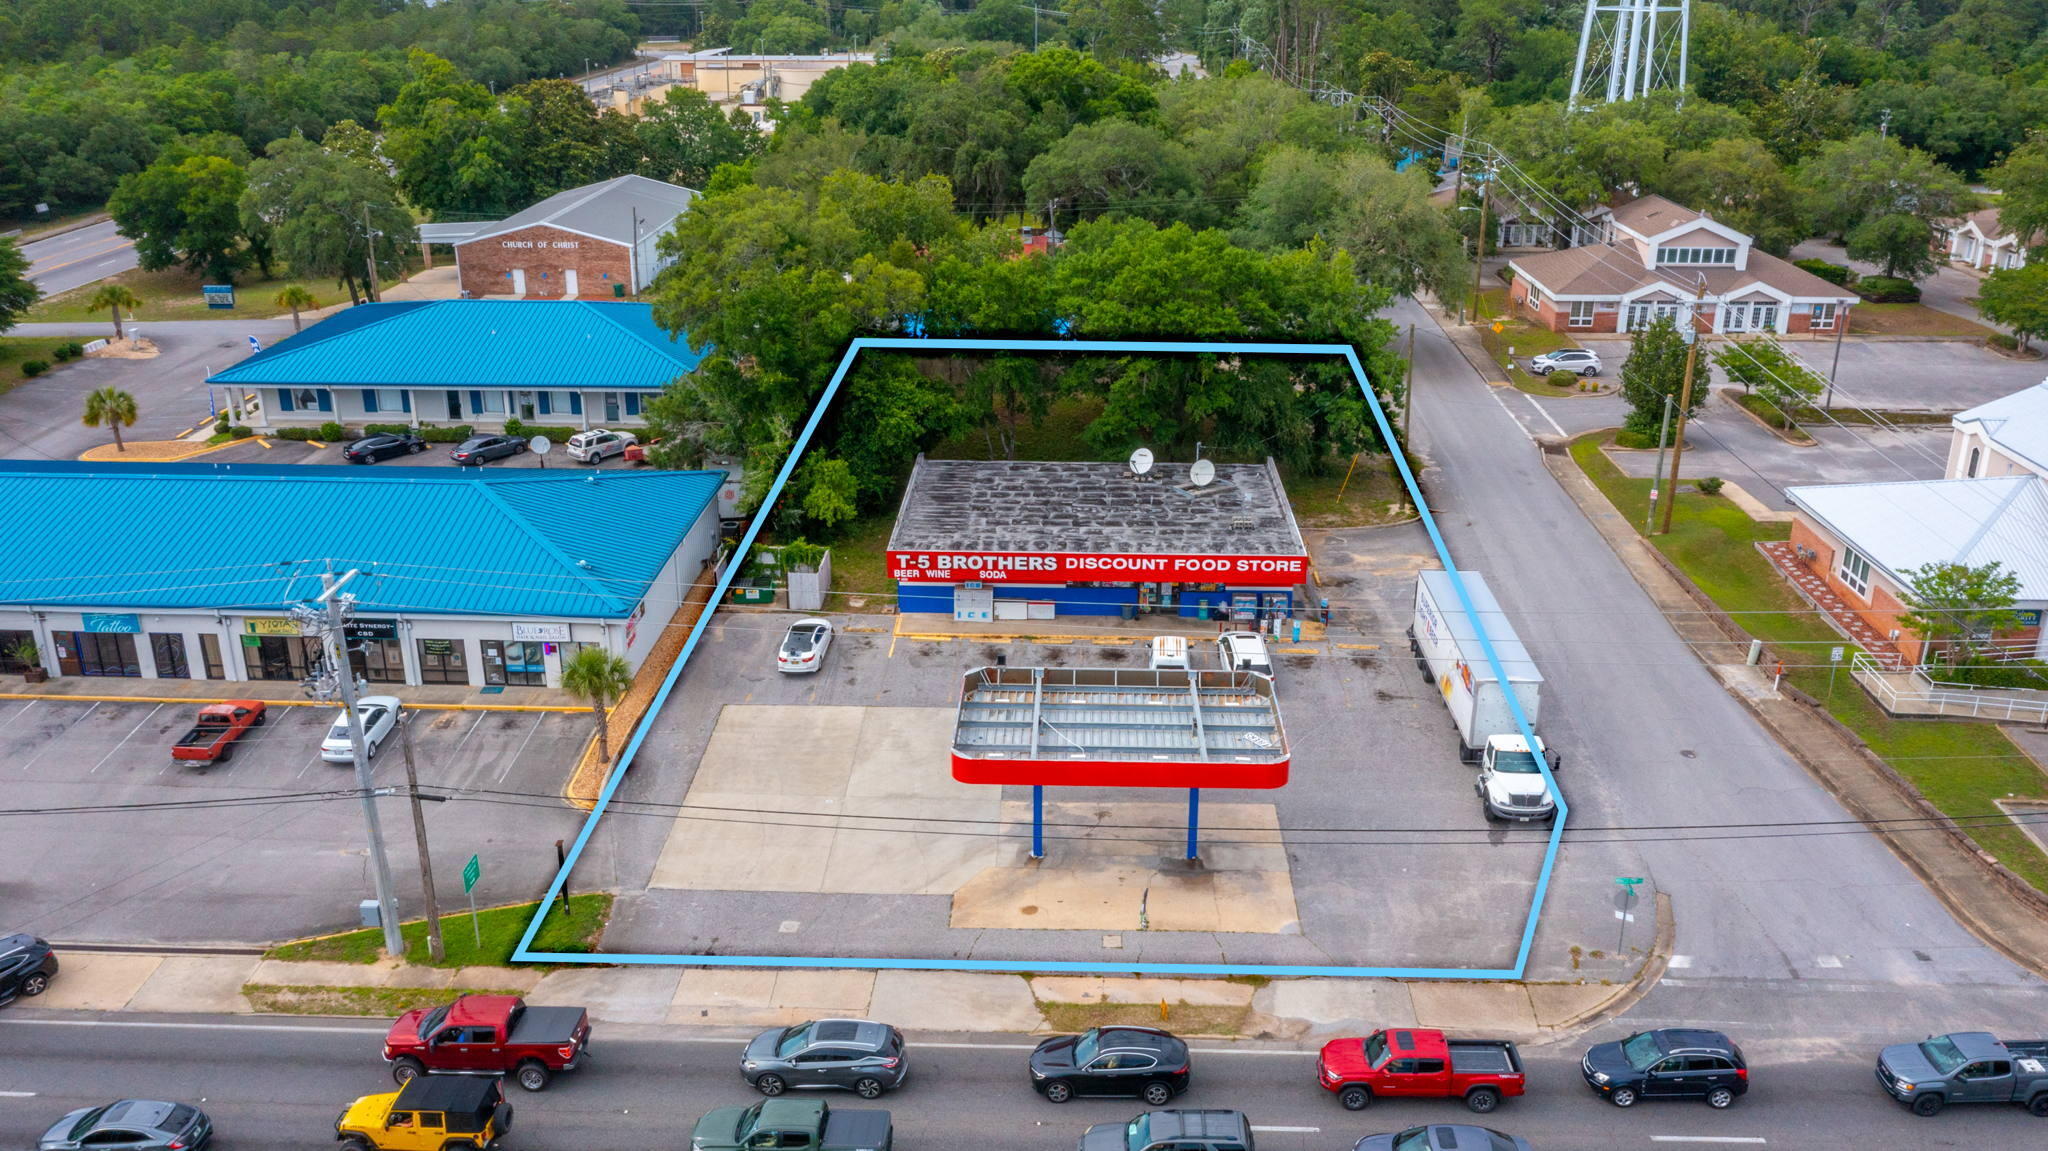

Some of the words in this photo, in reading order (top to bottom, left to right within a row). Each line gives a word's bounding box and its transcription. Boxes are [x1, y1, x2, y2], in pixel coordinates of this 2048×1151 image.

[502, 241, 533, 249] CHURCH
[537, 241, 548, 249] OF
[552, 241, 580, 249] CHRIST
[896, 554, 931, 569] T-5
[937, 555, 1058, 571] BROTHERS
[1066, 556, 1168, 571] DISCOUNT
[1174, 558, 1231, 572] FOOD
[1236, 559, 1302, 573] STORE
[893, 569, 920, 578] BEER
[925, 569, 951, 579] WINE
[979, 570, 1007, 579] SODA
[957, 611, 990, 619] ICE
[90, 619, 132, 632] Tattoo
[516, 624, 539, 635] BLUE
[543, 625, 566, 635] ROSE
